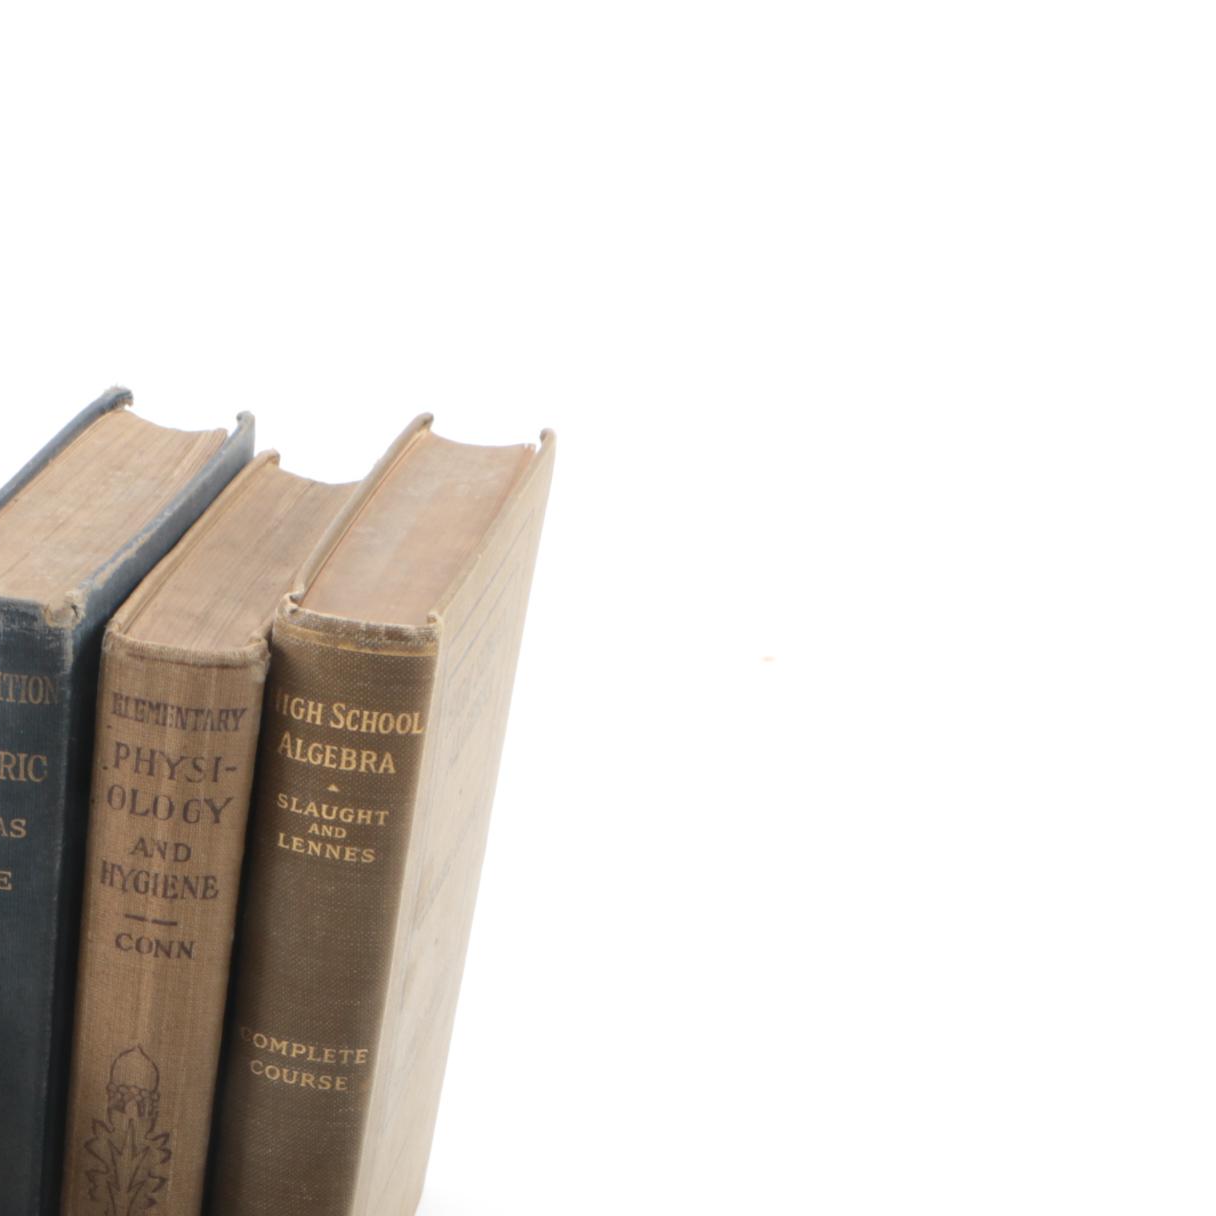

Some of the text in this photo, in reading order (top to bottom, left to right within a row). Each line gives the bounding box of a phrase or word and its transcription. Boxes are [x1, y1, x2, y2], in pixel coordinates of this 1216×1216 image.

[111, 692, 247, 732] ELEMENTARY
[330, 702, 425, 735] SCHOOL
[113, 741, 238, 783] PHYSI-
[278, 730, 396, 774] ALGEBRA
[107, 784, 233, 824] OLOGY
[276, 793, 389, 825] SLAUGHT
[308, 823, 347, 838] AND
[130, 837, 192, 863] AND
[277, 832, 376, 863] LENNES
[100, 860, 219, 900] HYGIENE
[115, 932, 195, 960] CONN
[250, 1060, 348, 1091] COURSE
